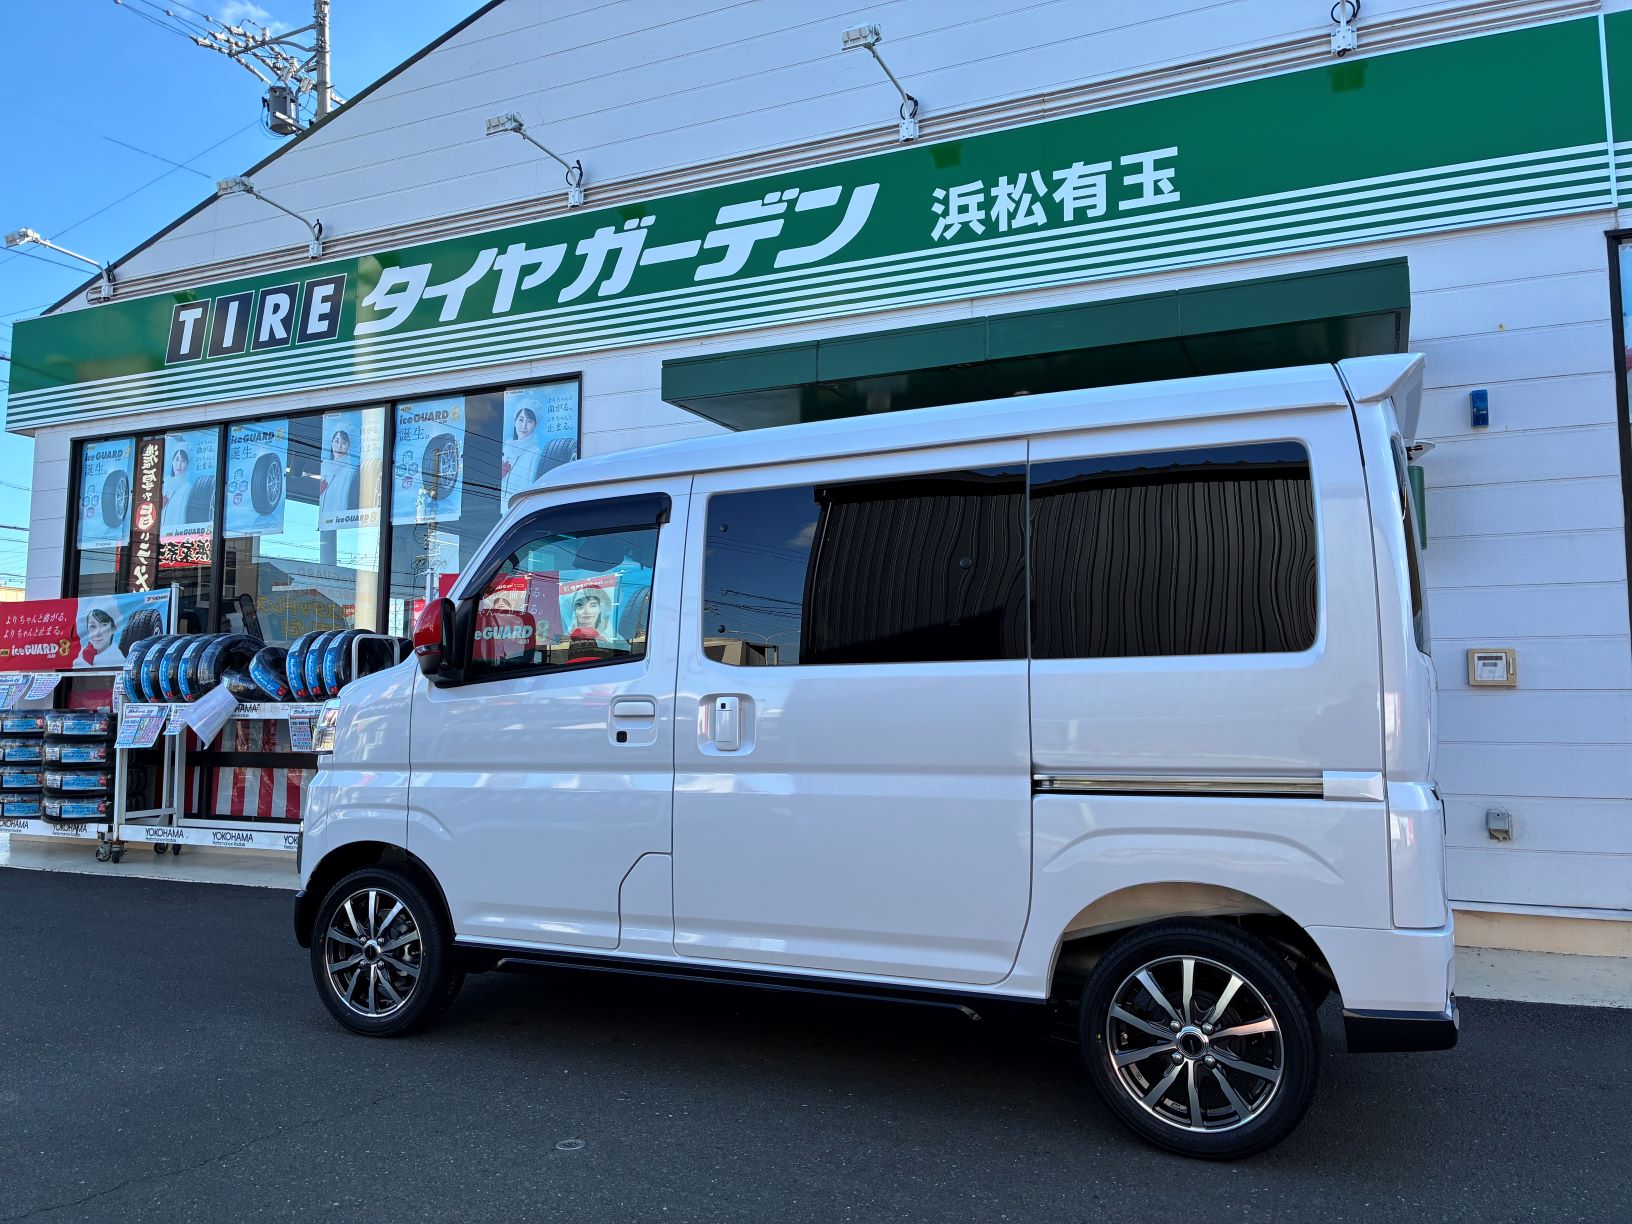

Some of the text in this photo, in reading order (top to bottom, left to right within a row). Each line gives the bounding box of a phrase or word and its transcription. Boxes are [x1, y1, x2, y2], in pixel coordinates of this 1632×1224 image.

[354, 146, 1181, 335] タイヤガーデン 浜松有玉
[179, 283, 335, 355] TIRE
[399, 410, 449, 425] iceGUARD
[231, 431, 275, 444] iceGUARD
[85, 449, 123, 461] iceGUARD
[335, 514, 369, 524] iceGUARD
[175, 528, 205, 536] iceGUARD
[474, 625, 533, 640] eGUARD
[12, 639, 70, 656] iceGUARD 8
[145, 828, 184, 839] YOKOHAMA
[212, 832, 254, 842] YOKOHAMA
